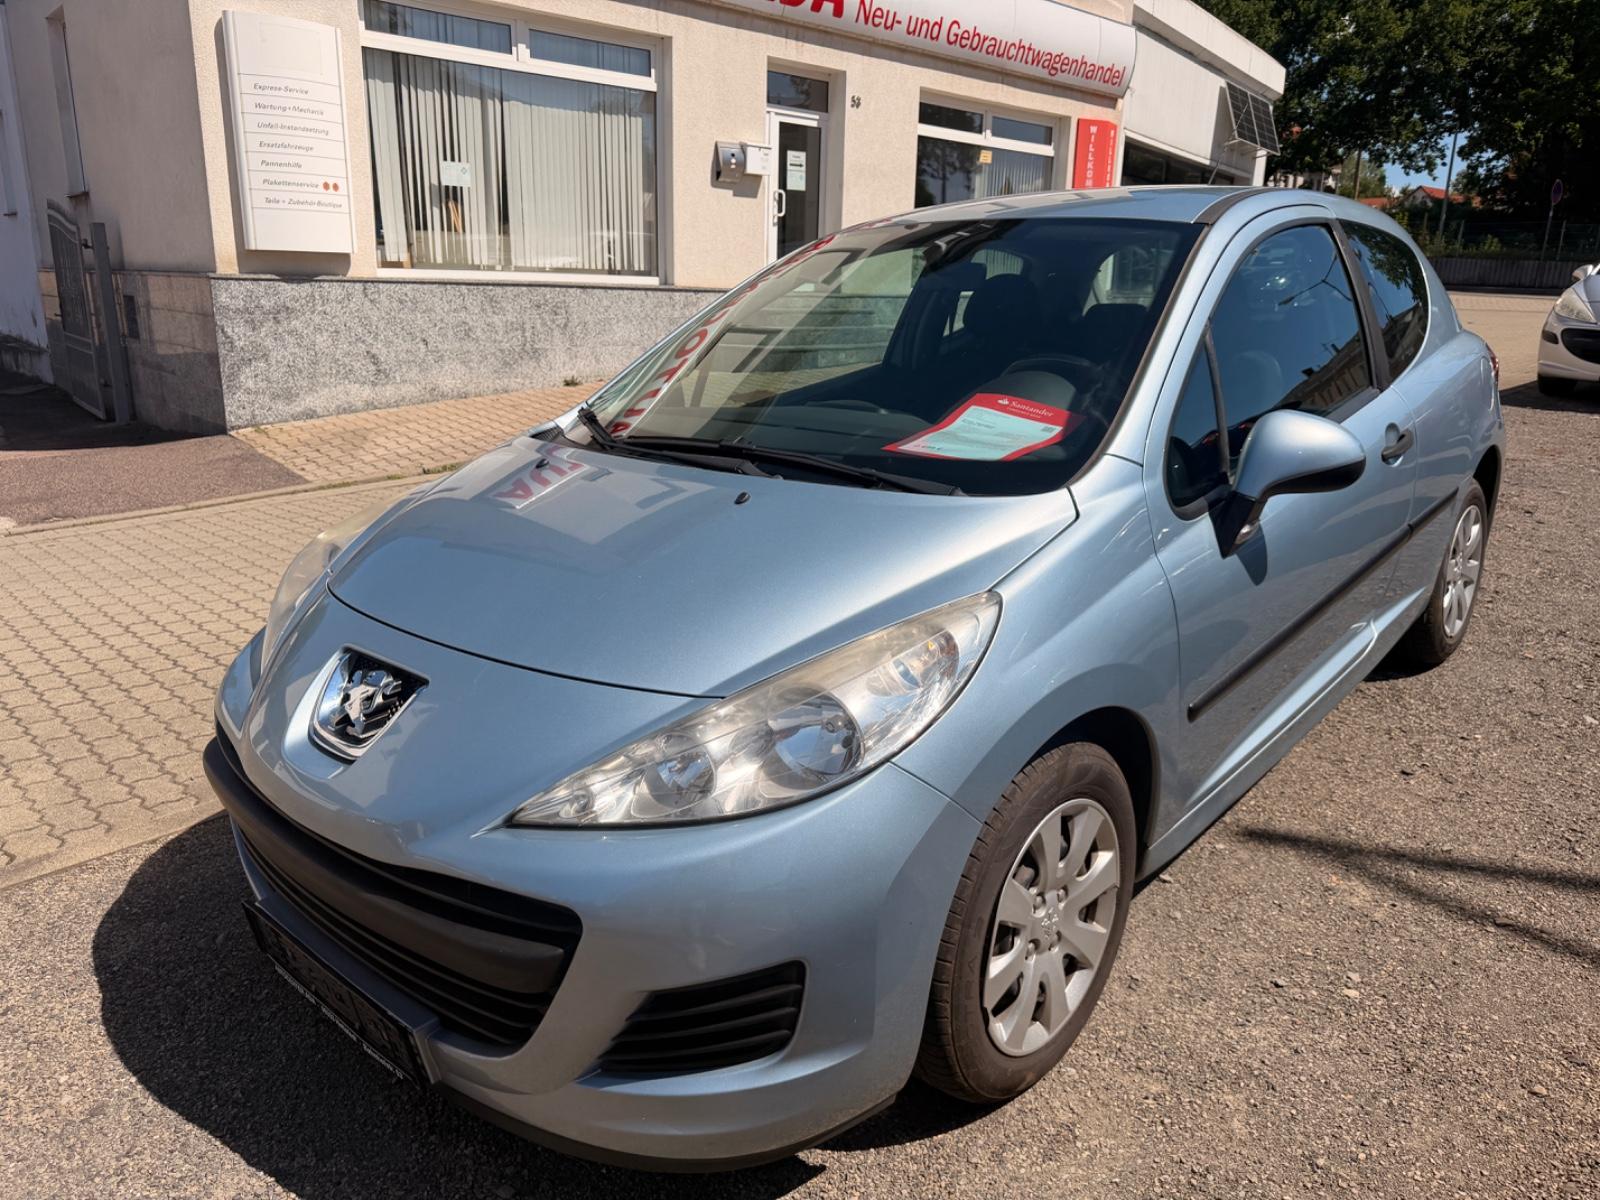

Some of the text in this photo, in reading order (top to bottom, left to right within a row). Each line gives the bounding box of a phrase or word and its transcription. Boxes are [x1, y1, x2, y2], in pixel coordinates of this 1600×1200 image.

[855, 0, 902, 31] Neu-
[906, 15, 943, 42] und
[946, 19, 1126, 88] Gebrauchtwagenhandel
[259, 141, 314, 152] Ersatzfahrzeuge
[261, 160, 303, 169] Pannenhilfe
[262, 179, 319, 189] Plakettenservice
[1010, 401, 1054, 417] Santander
